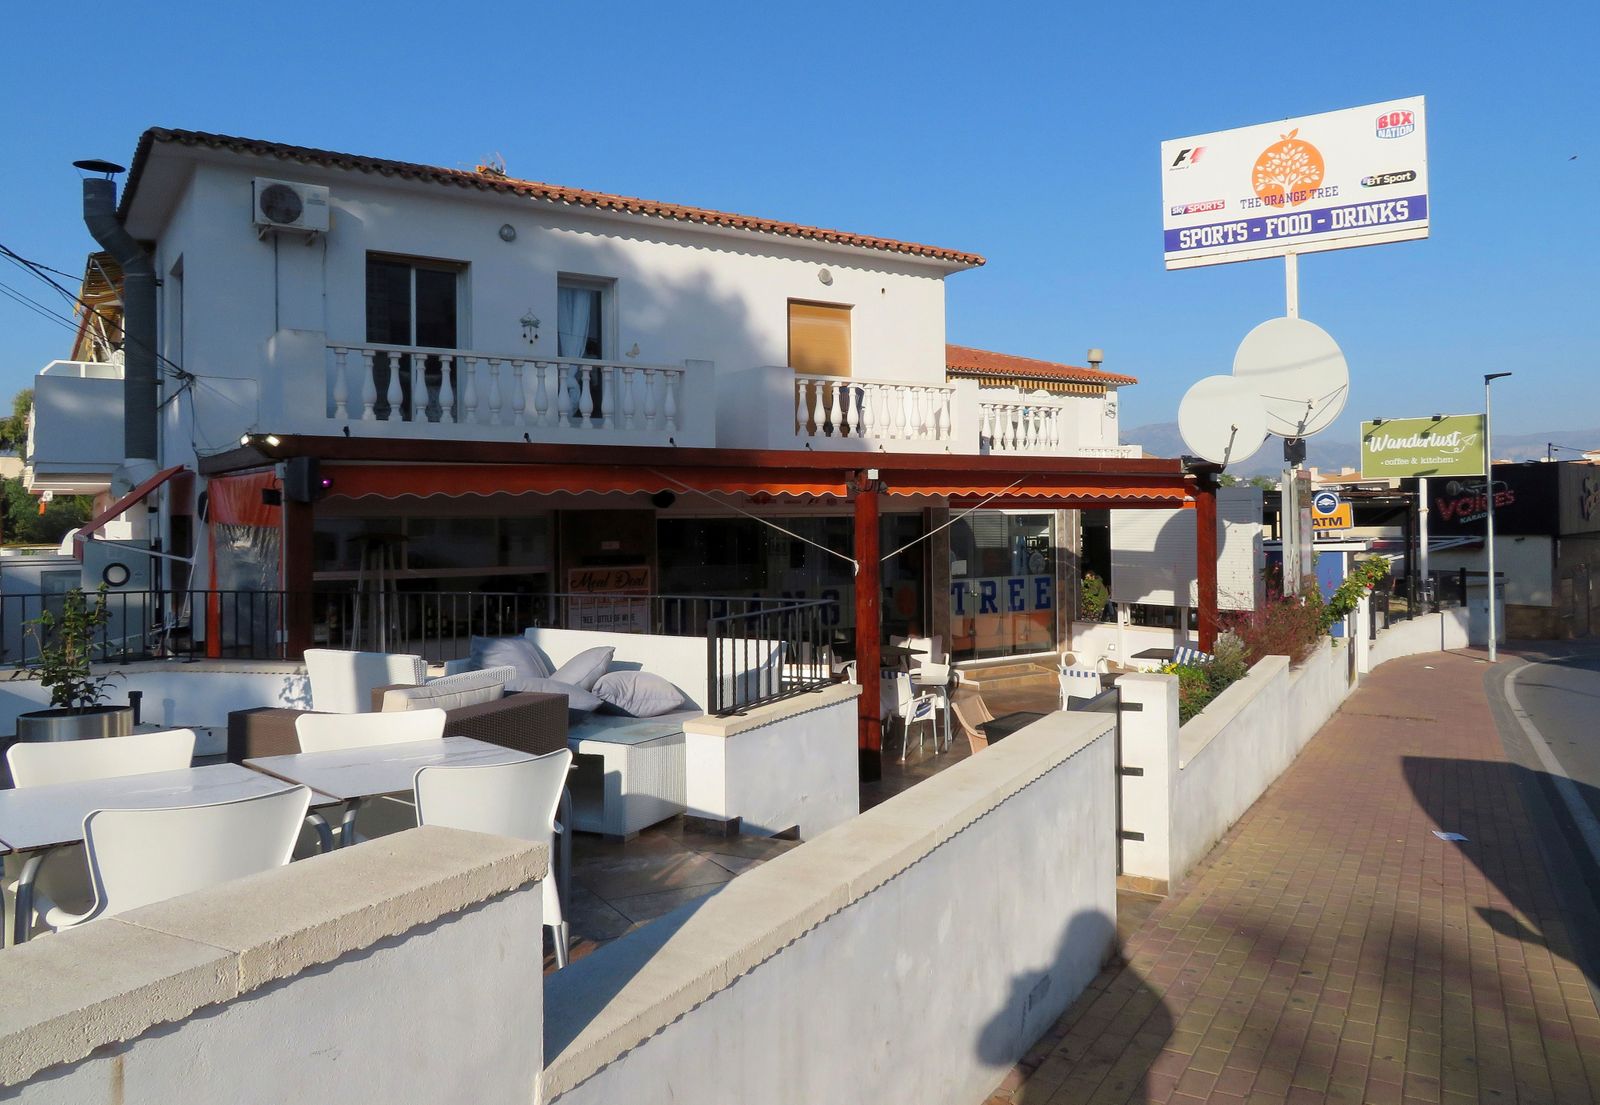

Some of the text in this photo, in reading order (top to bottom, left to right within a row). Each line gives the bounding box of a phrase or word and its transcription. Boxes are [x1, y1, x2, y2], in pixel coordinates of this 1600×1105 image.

[1378, 111, 1412, 129] BOX
[1378, 124, 1414, 138] NATION
[1367, 171, 1412, 186] BT Sport
[1240, 185, 1339, 209] THE ORANGE TREE
[1172, 200, 1225, 215] sky SPORTS
[1179, 222, 1248, 249] SPORTS
[1265, 213, 1312, 237] FOOD
[1331, 200, 1409, 230] DRINKS
[1369, 431, 1461, 453] Wanderlust
[1384, 455, 1454, 466] coffee & kitchen
[1312, 516, 1343, 527] ATM
[951, 577, 1052, 616] TREE
